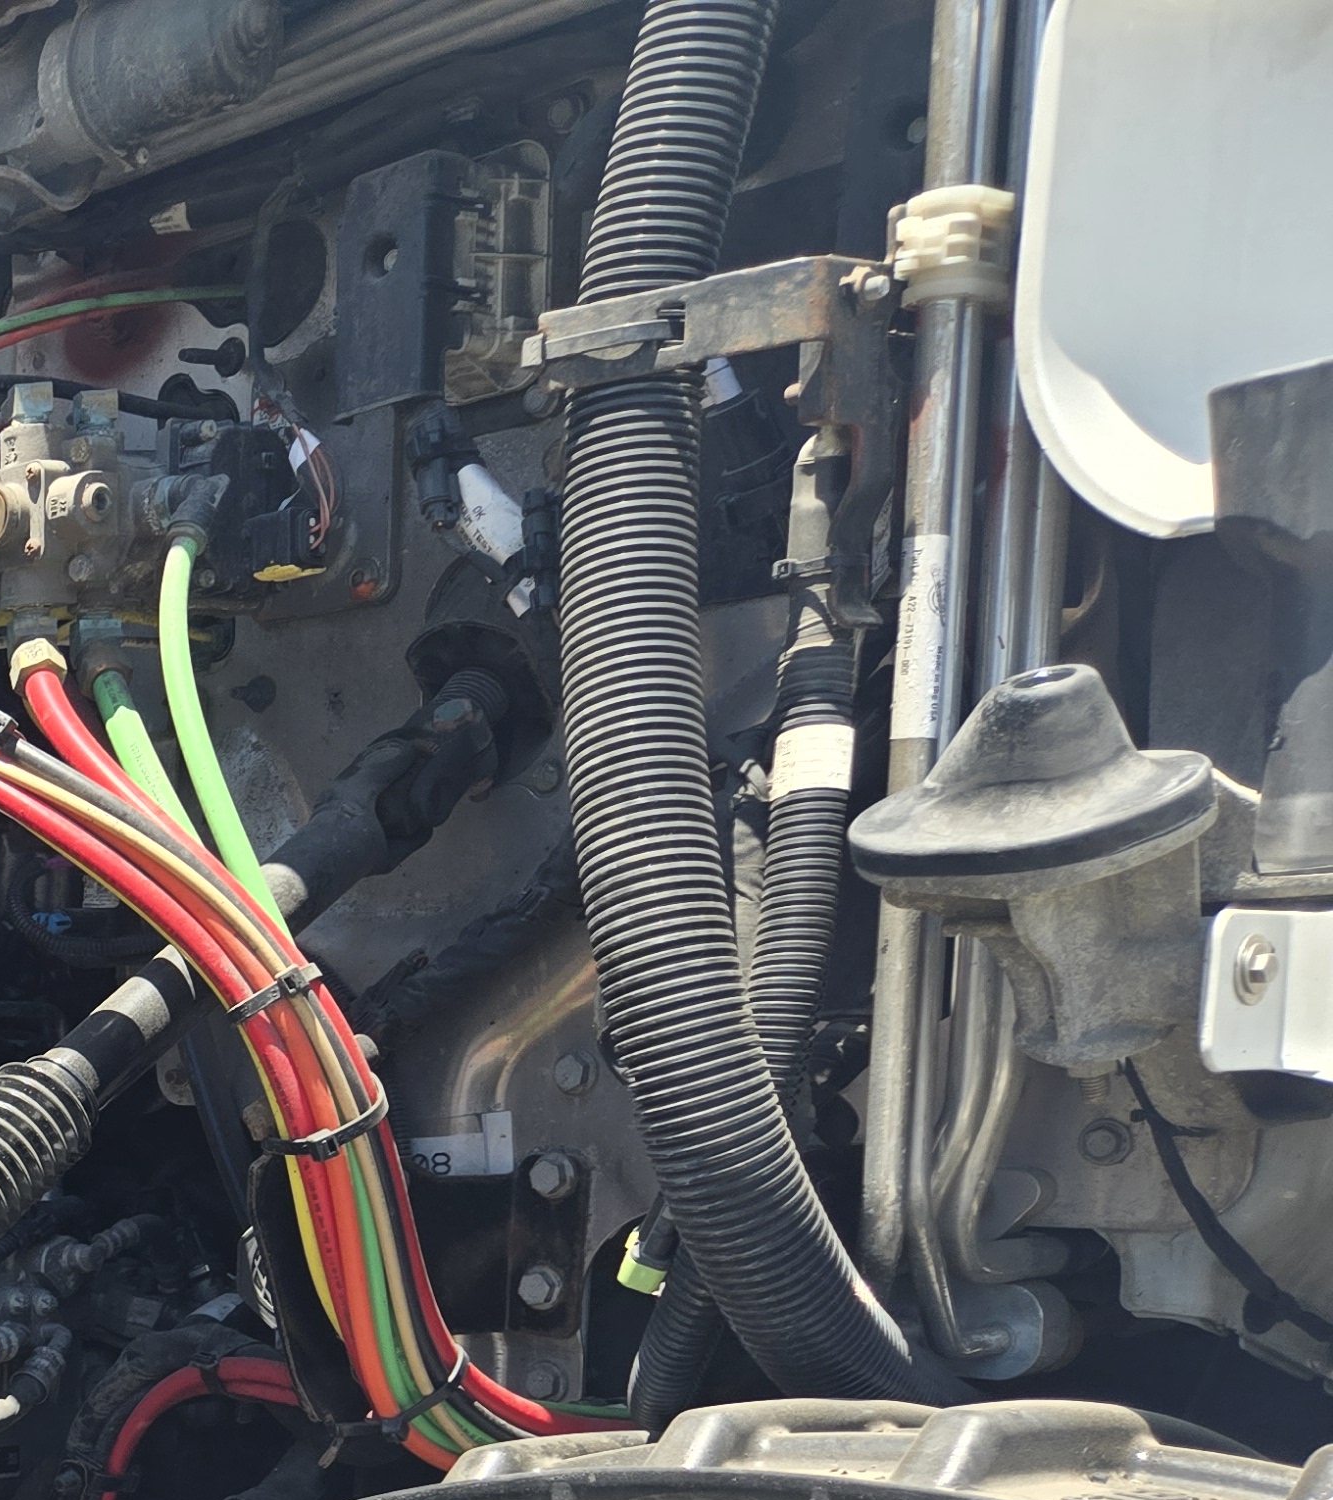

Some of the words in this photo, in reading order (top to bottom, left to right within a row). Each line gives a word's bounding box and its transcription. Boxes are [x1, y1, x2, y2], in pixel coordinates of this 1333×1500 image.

[473, 505, 486, 520] OK
[473, 528, 493, 553] TEST
[936, 675, 941, 684] in
[933, 686, 941, 702] the
[930, 703, 939, 721] USA
